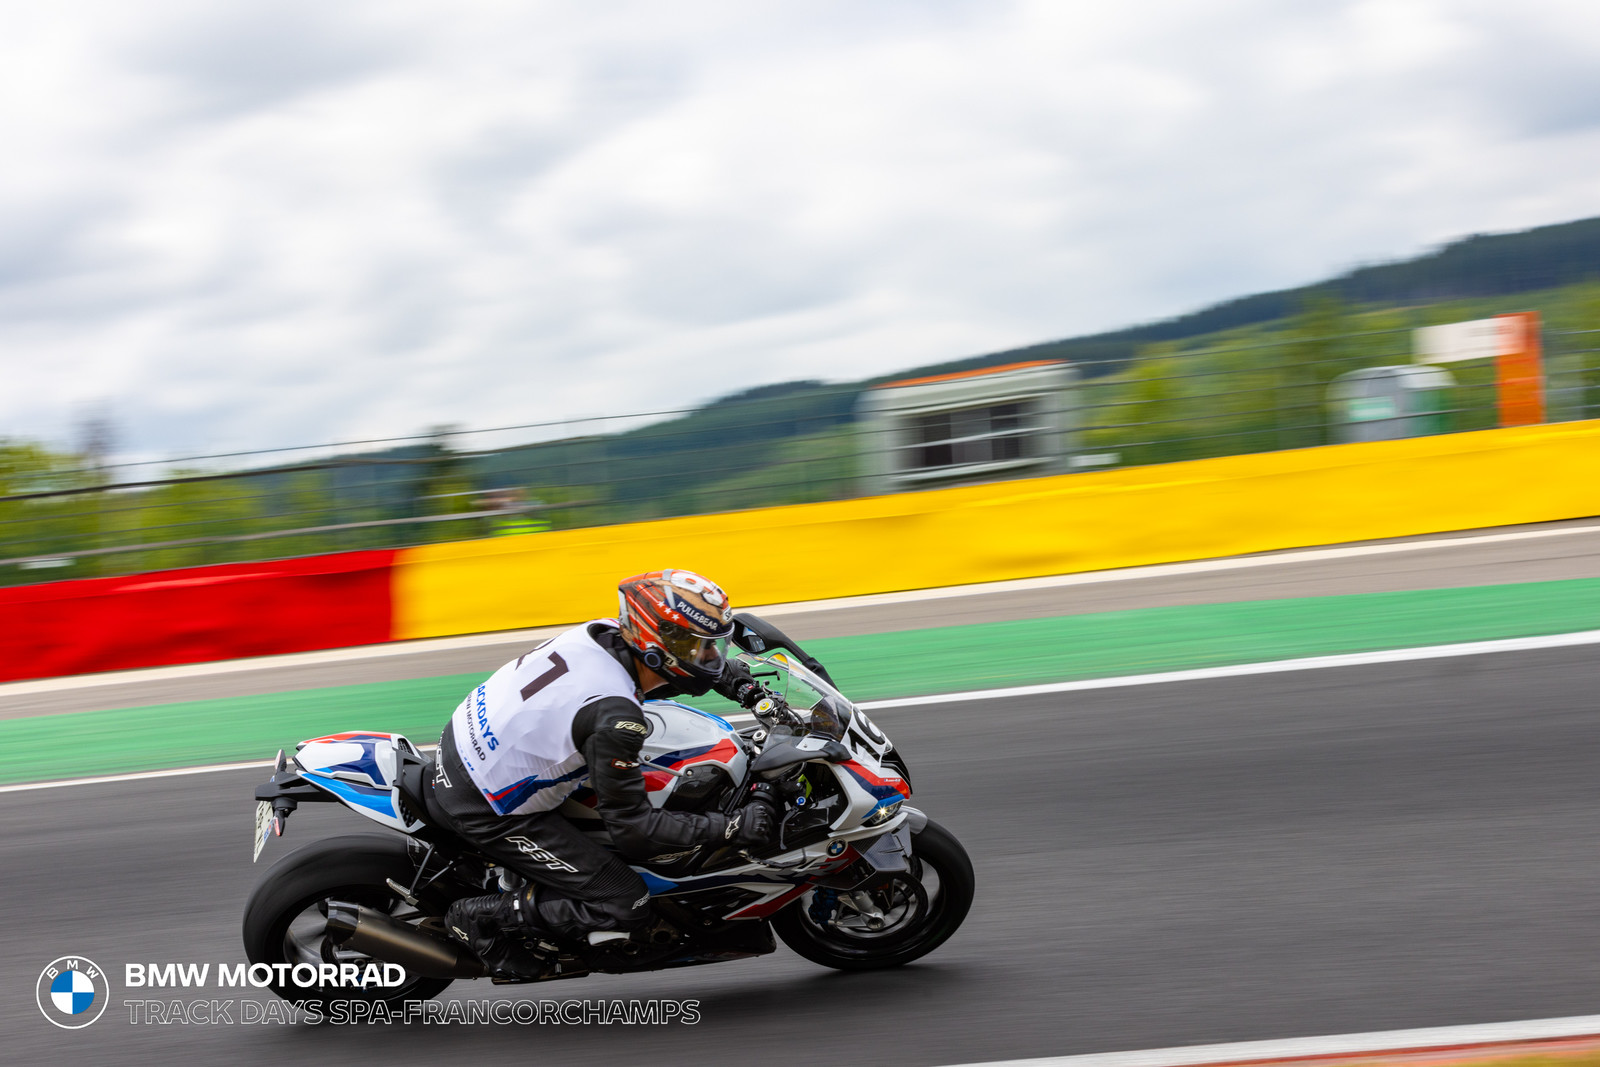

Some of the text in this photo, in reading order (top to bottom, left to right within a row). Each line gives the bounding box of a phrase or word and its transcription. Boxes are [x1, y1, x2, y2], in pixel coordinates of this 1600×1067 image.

[677, 601, 719, 631] PULL&BEAR
[466, 711, 487, 762] MOTORRAD
[476, 683, 500, 752] ACKDAYS
[505, 835, 579, 874] RST
